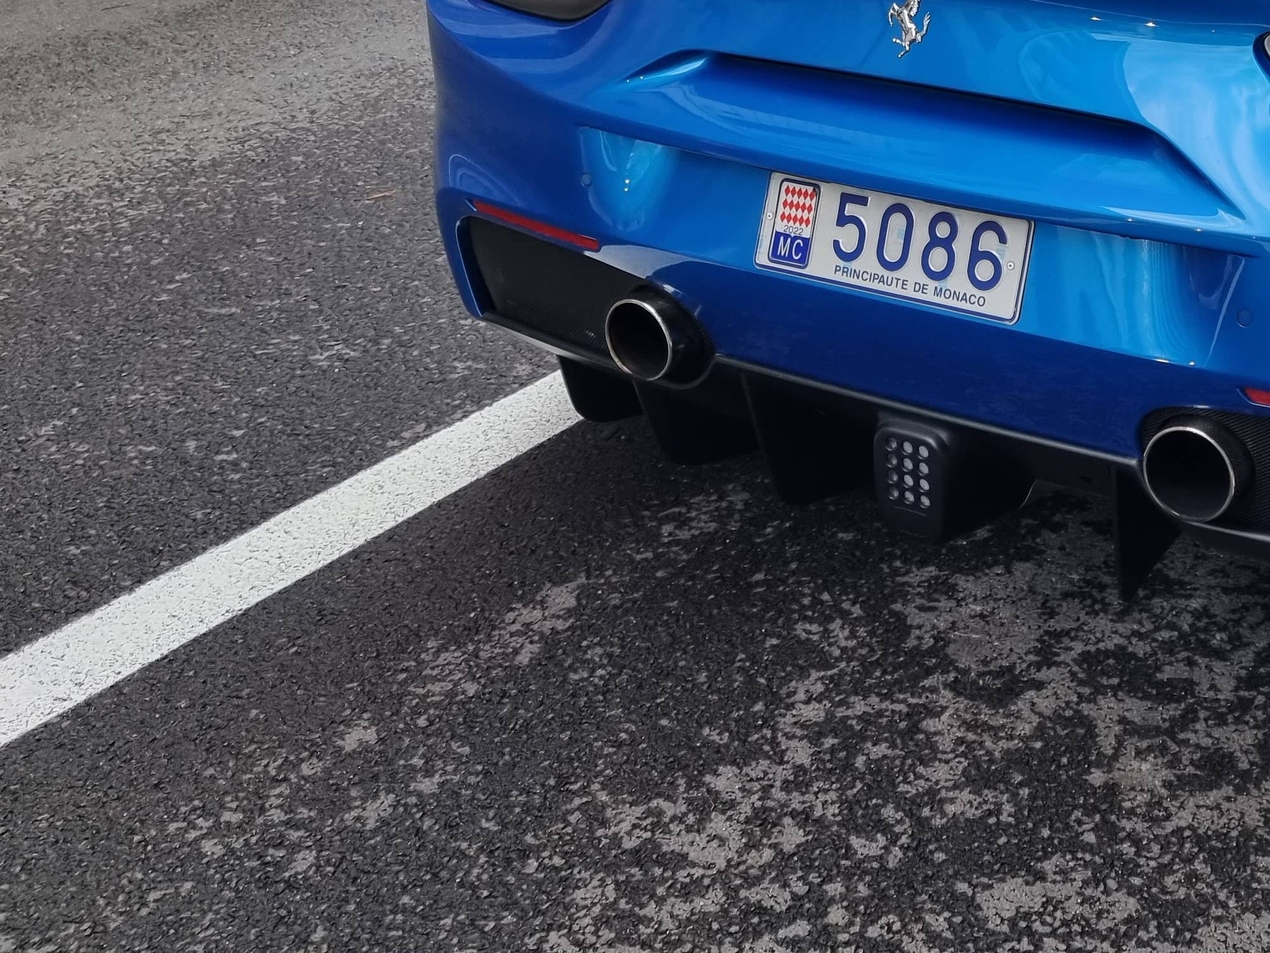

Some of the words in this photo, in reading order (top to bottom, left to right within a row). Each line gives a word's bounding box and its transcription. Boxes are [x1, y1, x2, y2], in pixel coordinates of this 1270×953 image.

[783, 224, 804, 236] 2022
[833, 192, 1008, 292] 5086
[777, 235, 803, 260] MC
[833, 264, 909, 291] PRINCIPAUTE
[913, 281, 929, 295] DE
[933, 286, 986, 308] MONACO
